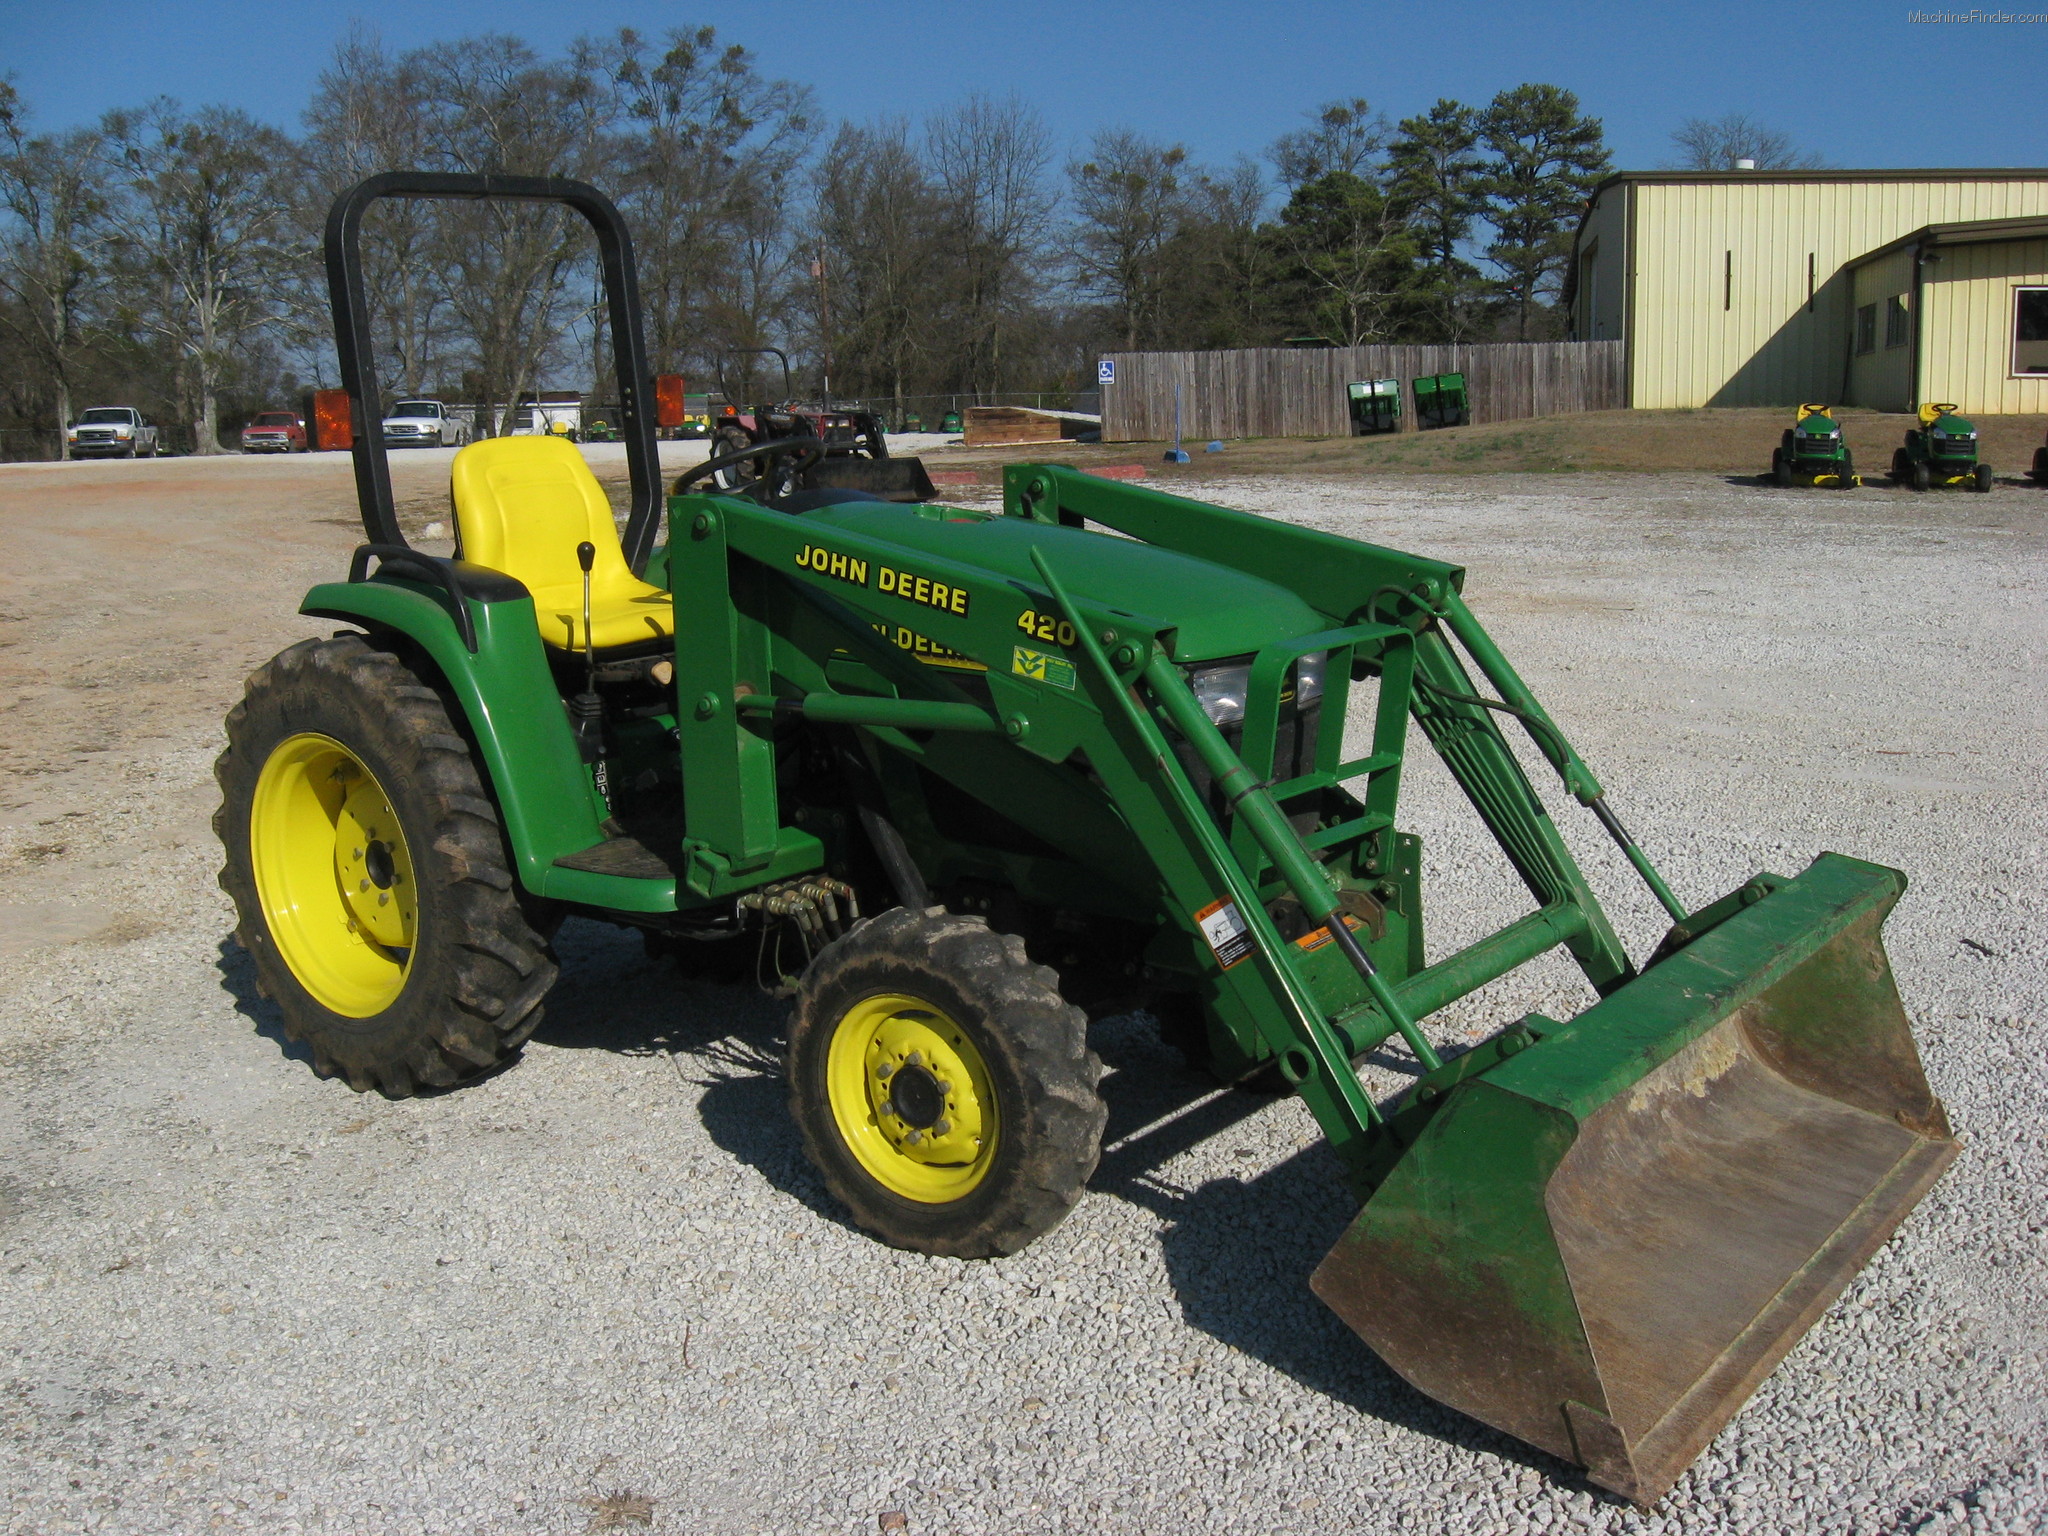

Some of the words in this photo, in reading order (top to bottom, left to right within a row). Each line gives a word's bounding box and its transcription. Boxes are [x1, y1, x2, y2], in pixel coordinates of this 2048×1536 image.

[795, 544, 869, 587] JOHN
[878, 565, 968, 616] DEERE
[1017, 609, 1077, 647] 420
